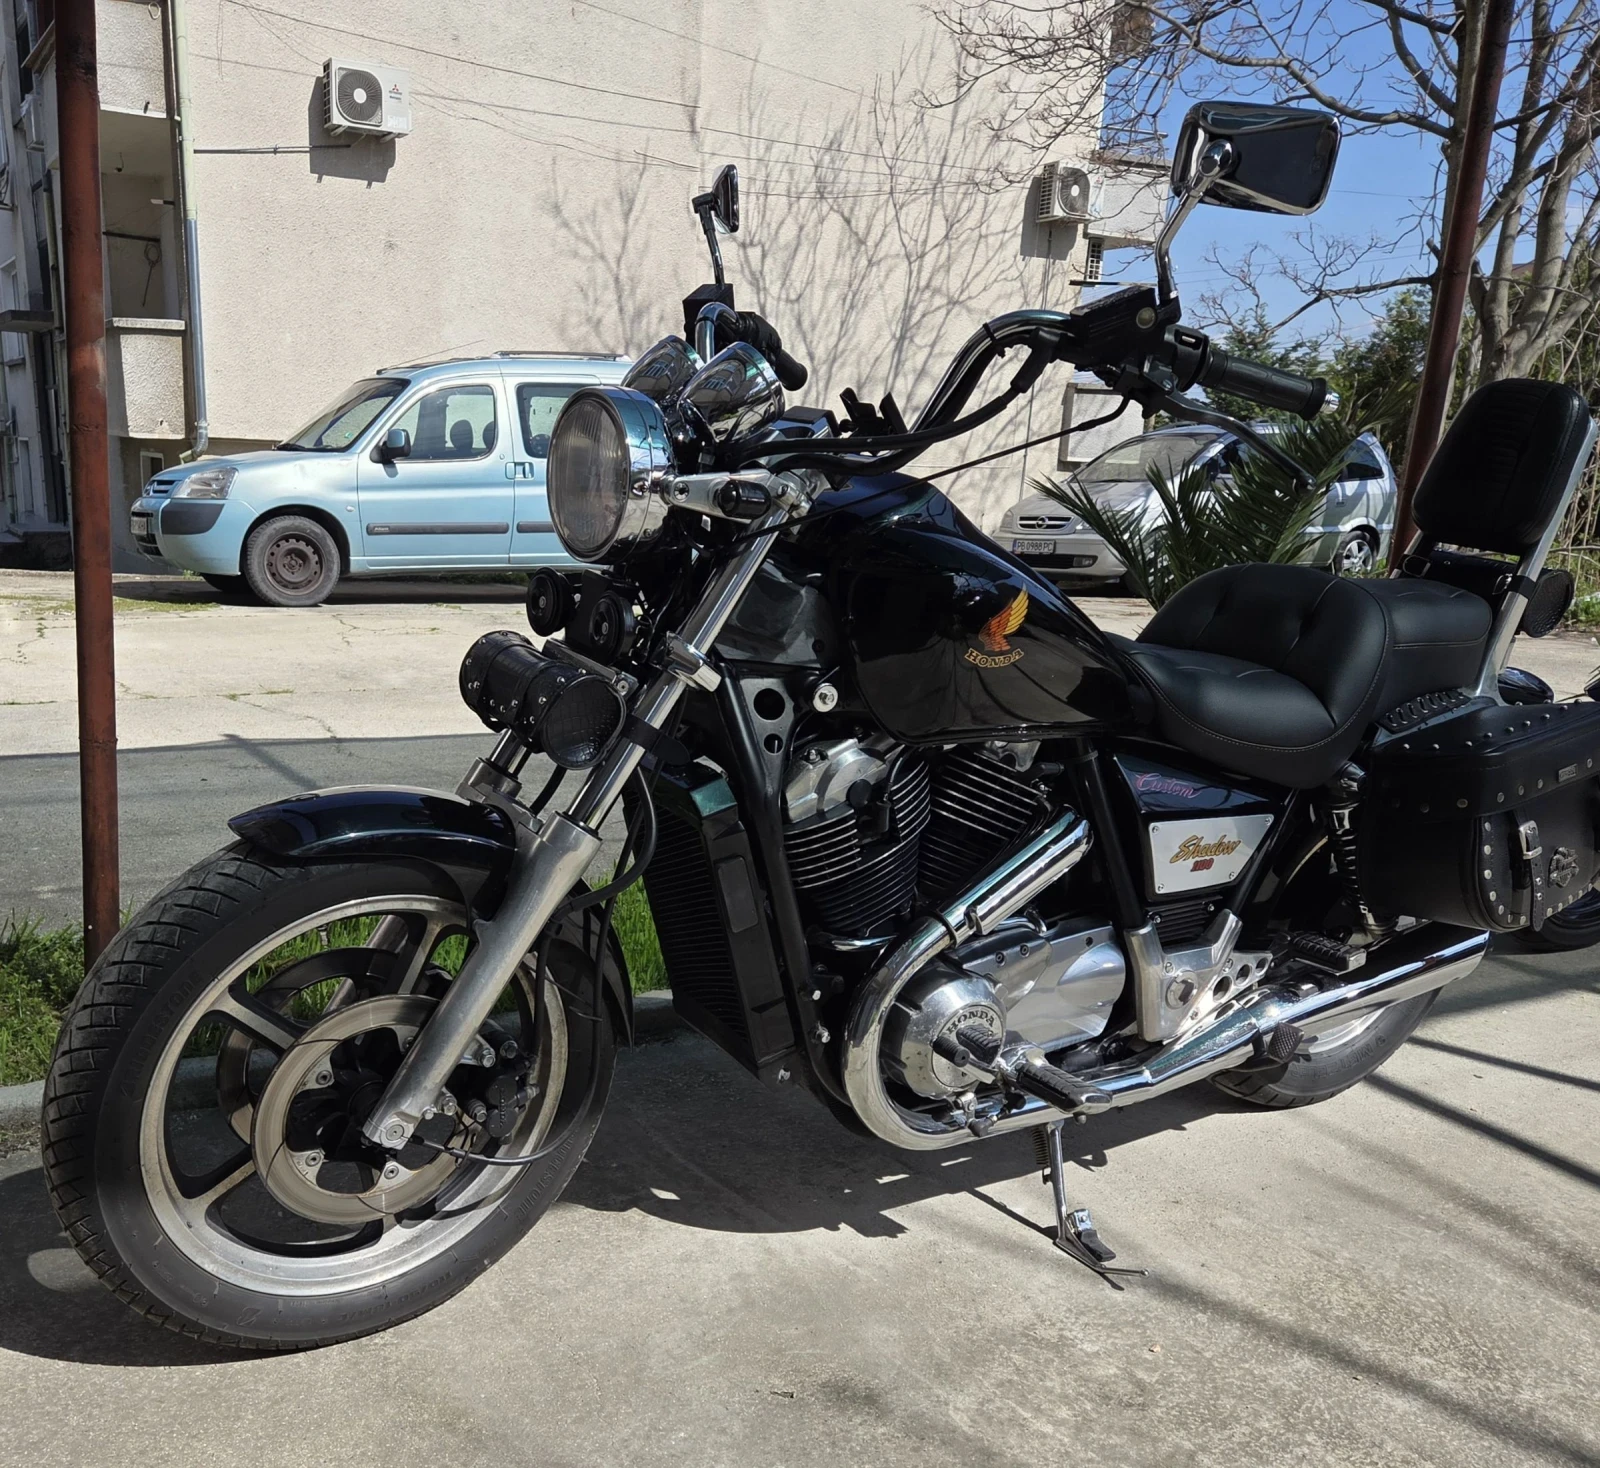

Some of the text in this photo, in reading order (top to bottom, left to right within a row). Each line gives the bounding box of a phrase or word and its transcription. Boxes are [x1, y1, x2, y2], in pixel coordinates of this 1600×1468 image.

[1017, 541, 1053, 552] PB 0988 PC
[964, 647, 1025, 668] HONDA
[1136, 772, 1202, 799] Custom
[1169, 834, 1242, 864] Shadow
[946, 1009, 996, 1036] HONDA
